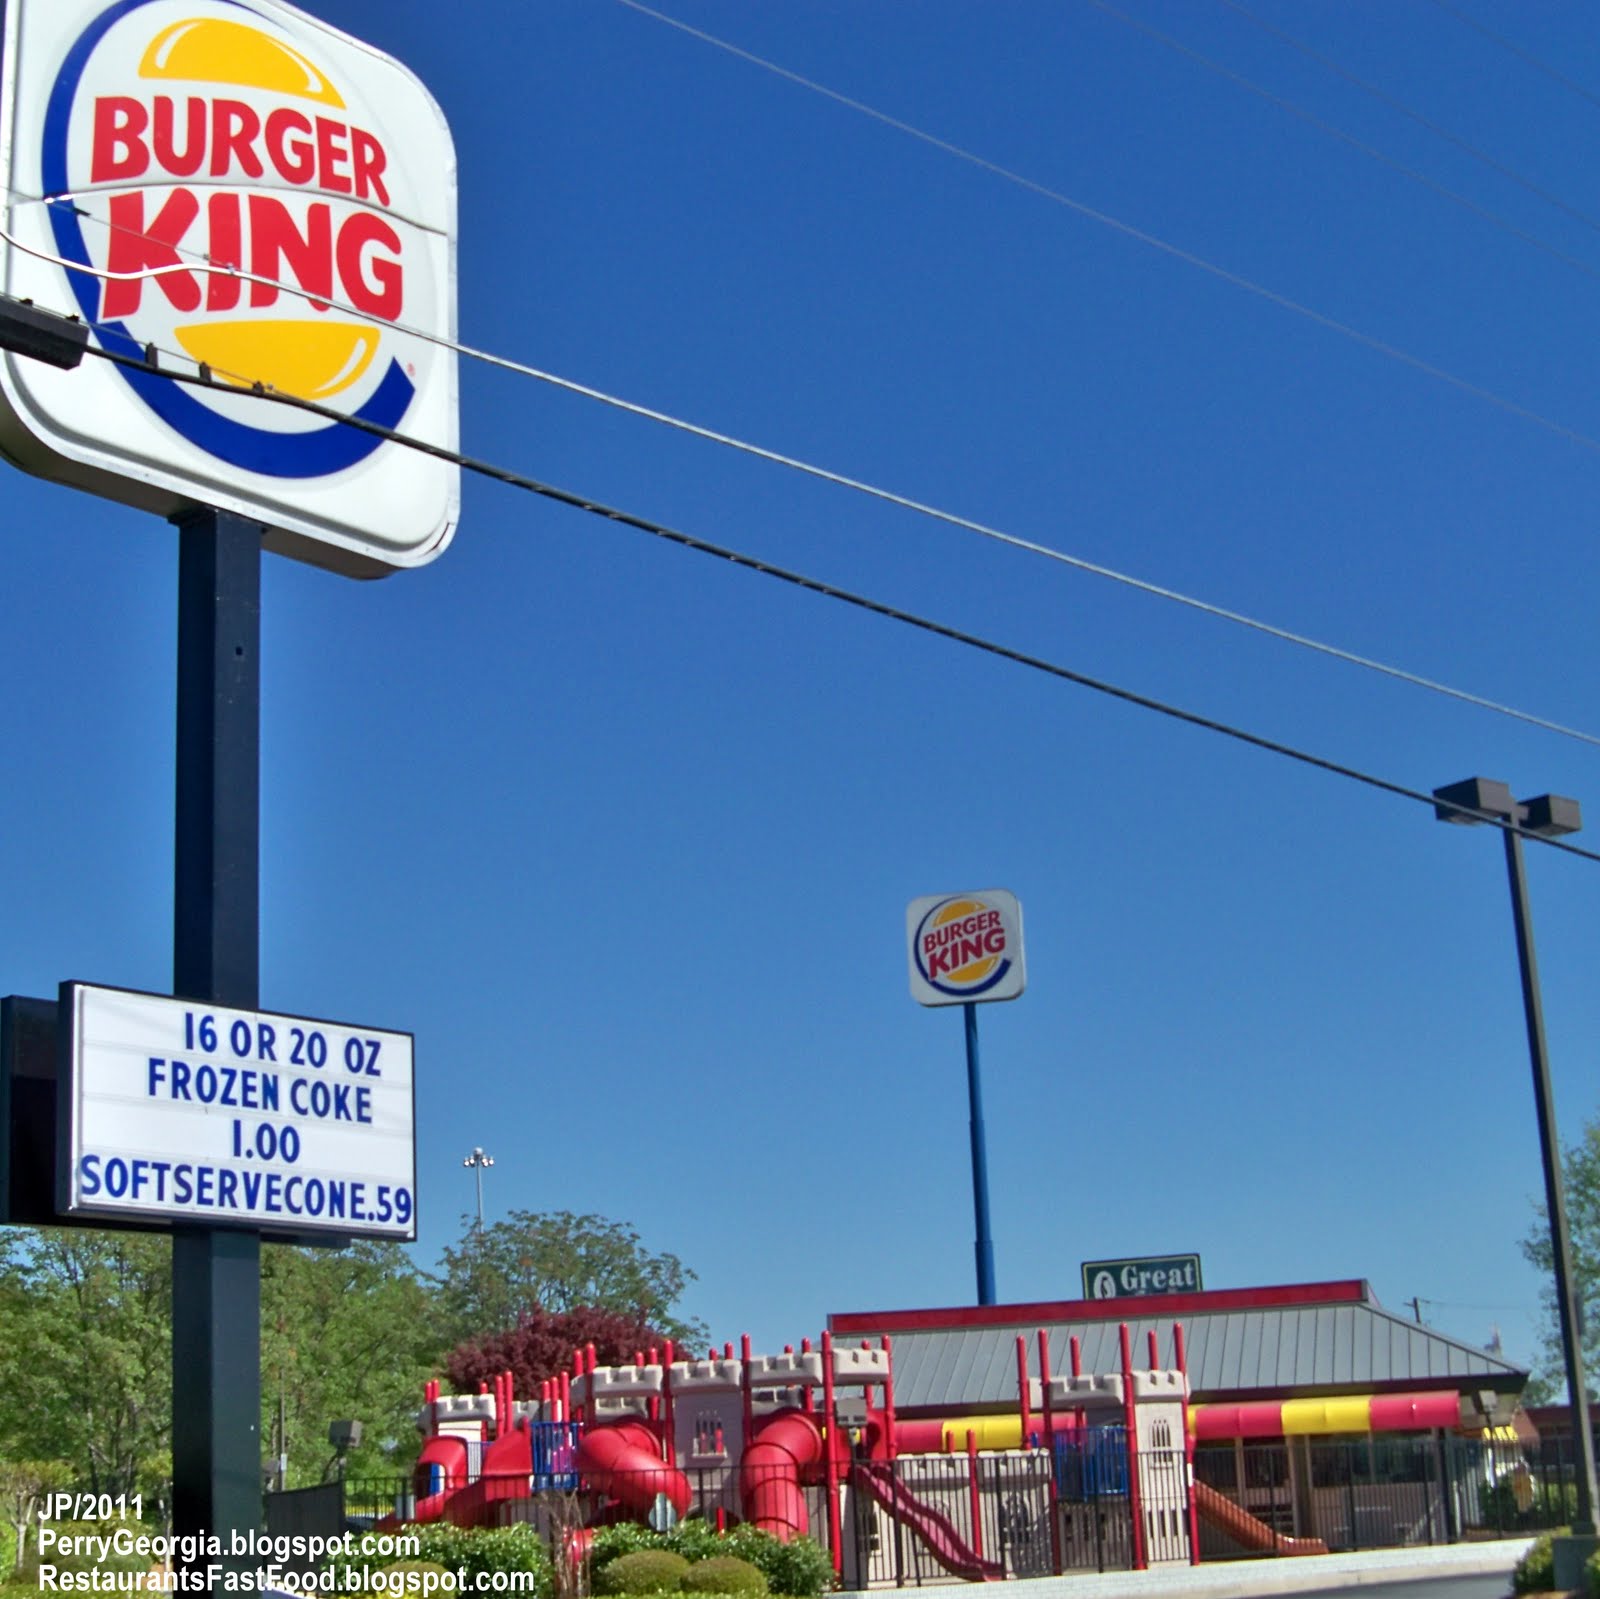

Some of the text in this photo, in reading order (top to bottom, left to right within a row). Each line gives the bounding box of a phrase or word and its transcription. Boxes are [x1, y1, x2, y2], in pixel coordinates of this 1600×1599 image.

[91, 95, 390, 207] BURGER
[102, 187, 403, 322] KING
[923, 910, 1001, 954] BURGER
[928, 927, 1006, 979] KING
[184, 1012, 381, 1076] 16 OR 20 OZ
[148, 1057, 372, 1124] FROZEN COKE
[233, 1119, 301, 1163] 1.00
[1121, 1262, 1195, 1291] Great
